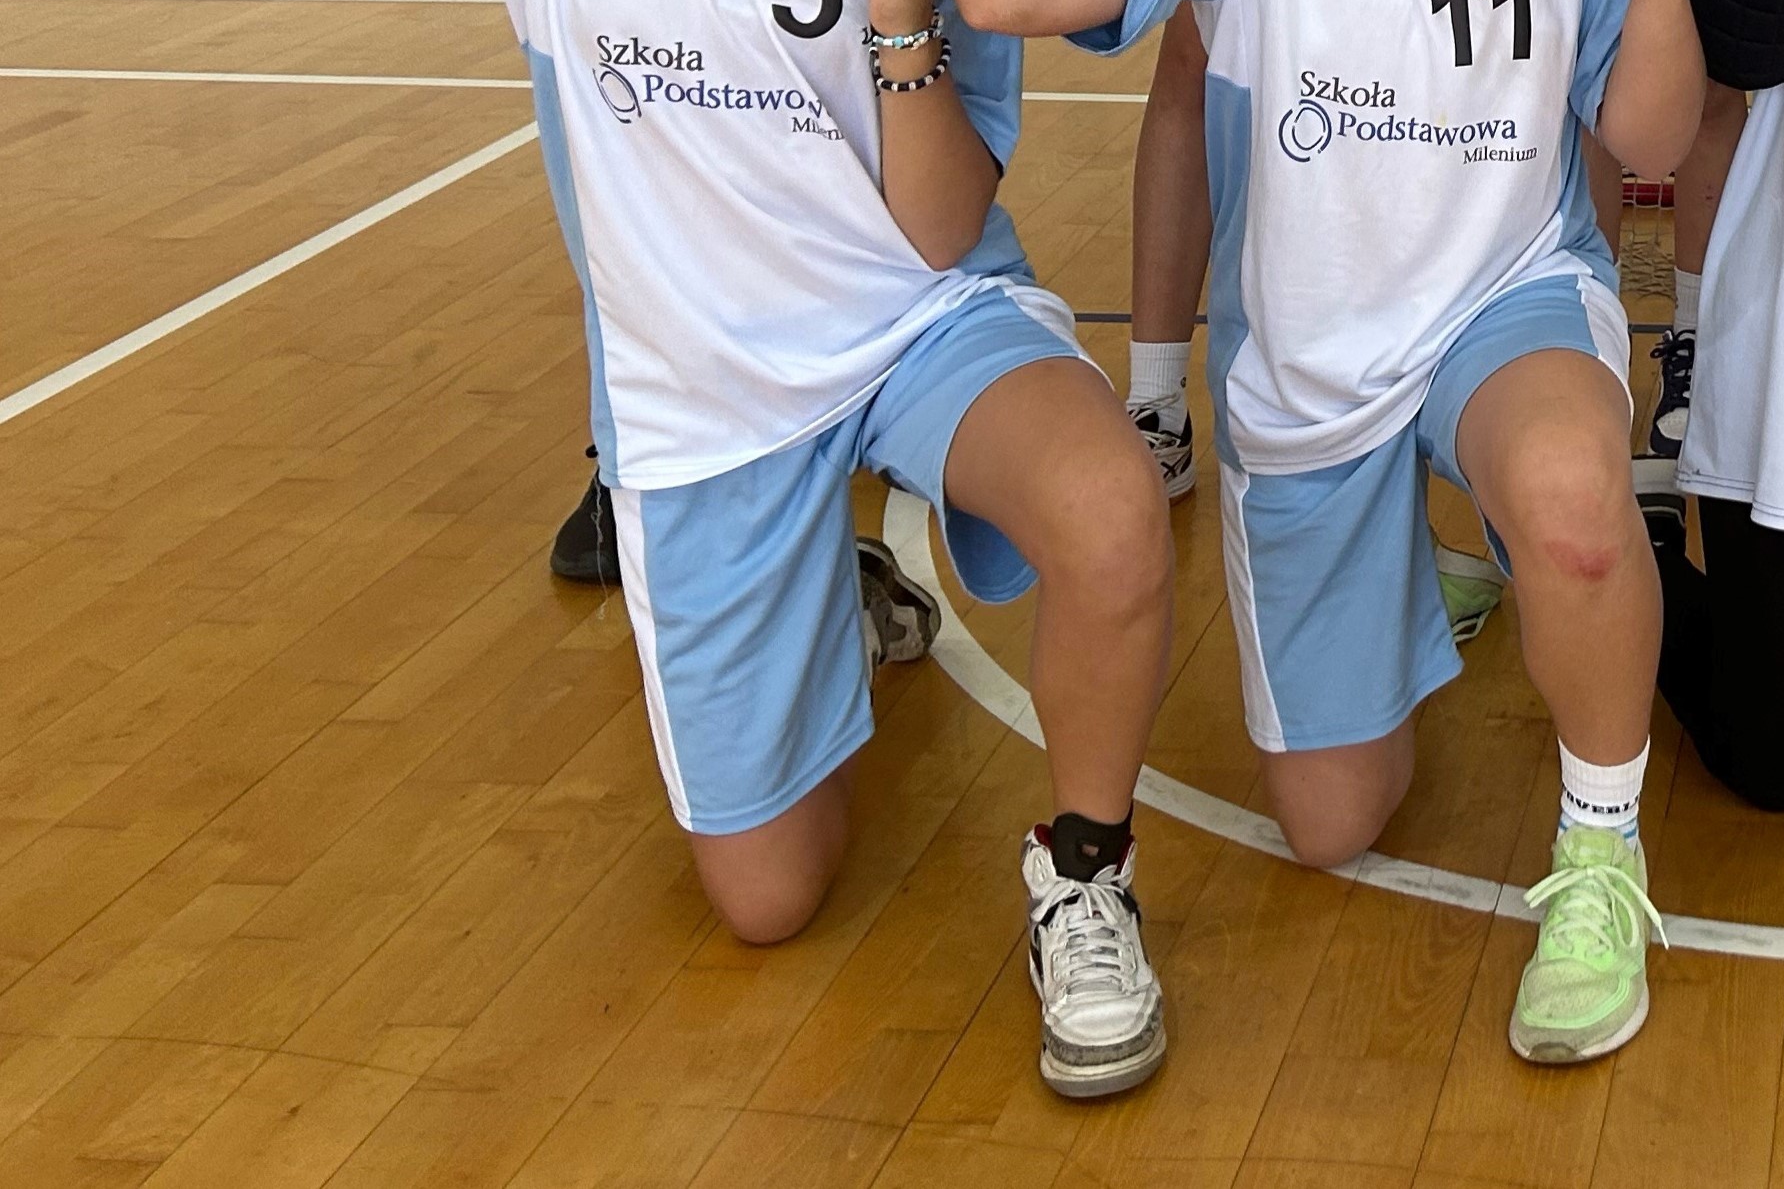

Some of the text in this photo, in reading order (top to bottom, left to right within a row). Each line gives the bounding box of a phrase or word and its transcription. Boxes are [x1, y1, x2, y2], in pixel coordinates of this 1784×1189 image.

[596, 35, 705, 72] Szkoła
[1300, 71, 1396, 108] Szkoła
[1337, 110, 1518, 146] Podstawowa
[1463, 147, 1538, 165] Milenium
